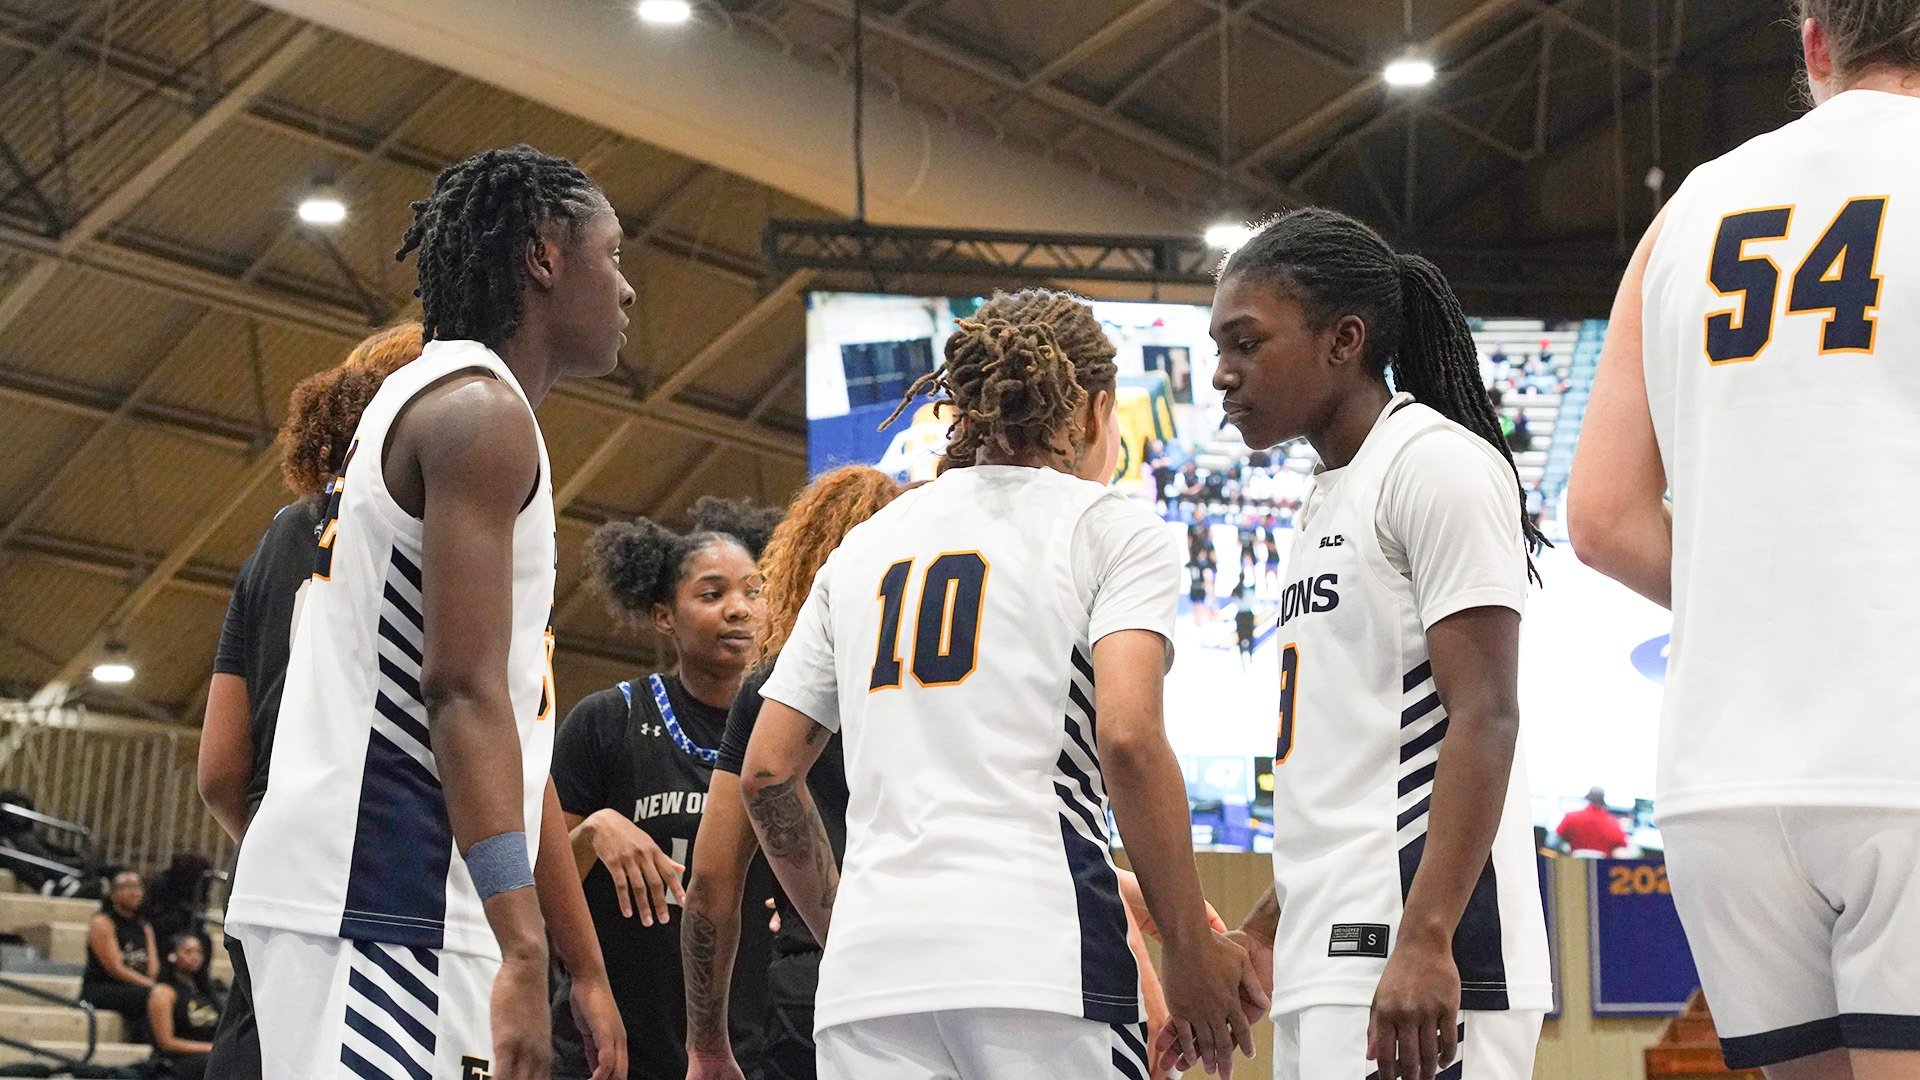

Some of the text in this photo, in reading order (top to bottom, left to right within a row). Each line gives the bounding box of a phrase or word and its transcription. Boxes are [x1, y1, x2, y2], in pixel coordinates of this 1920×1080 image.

[1704, 195, 1890, 366] 54
[868, 550, 991, 694] 10
[1277, 573, 1340, 628] IONS
[633, 792, 685, 823] NEW
[1367, 933, 1377, 946] S
